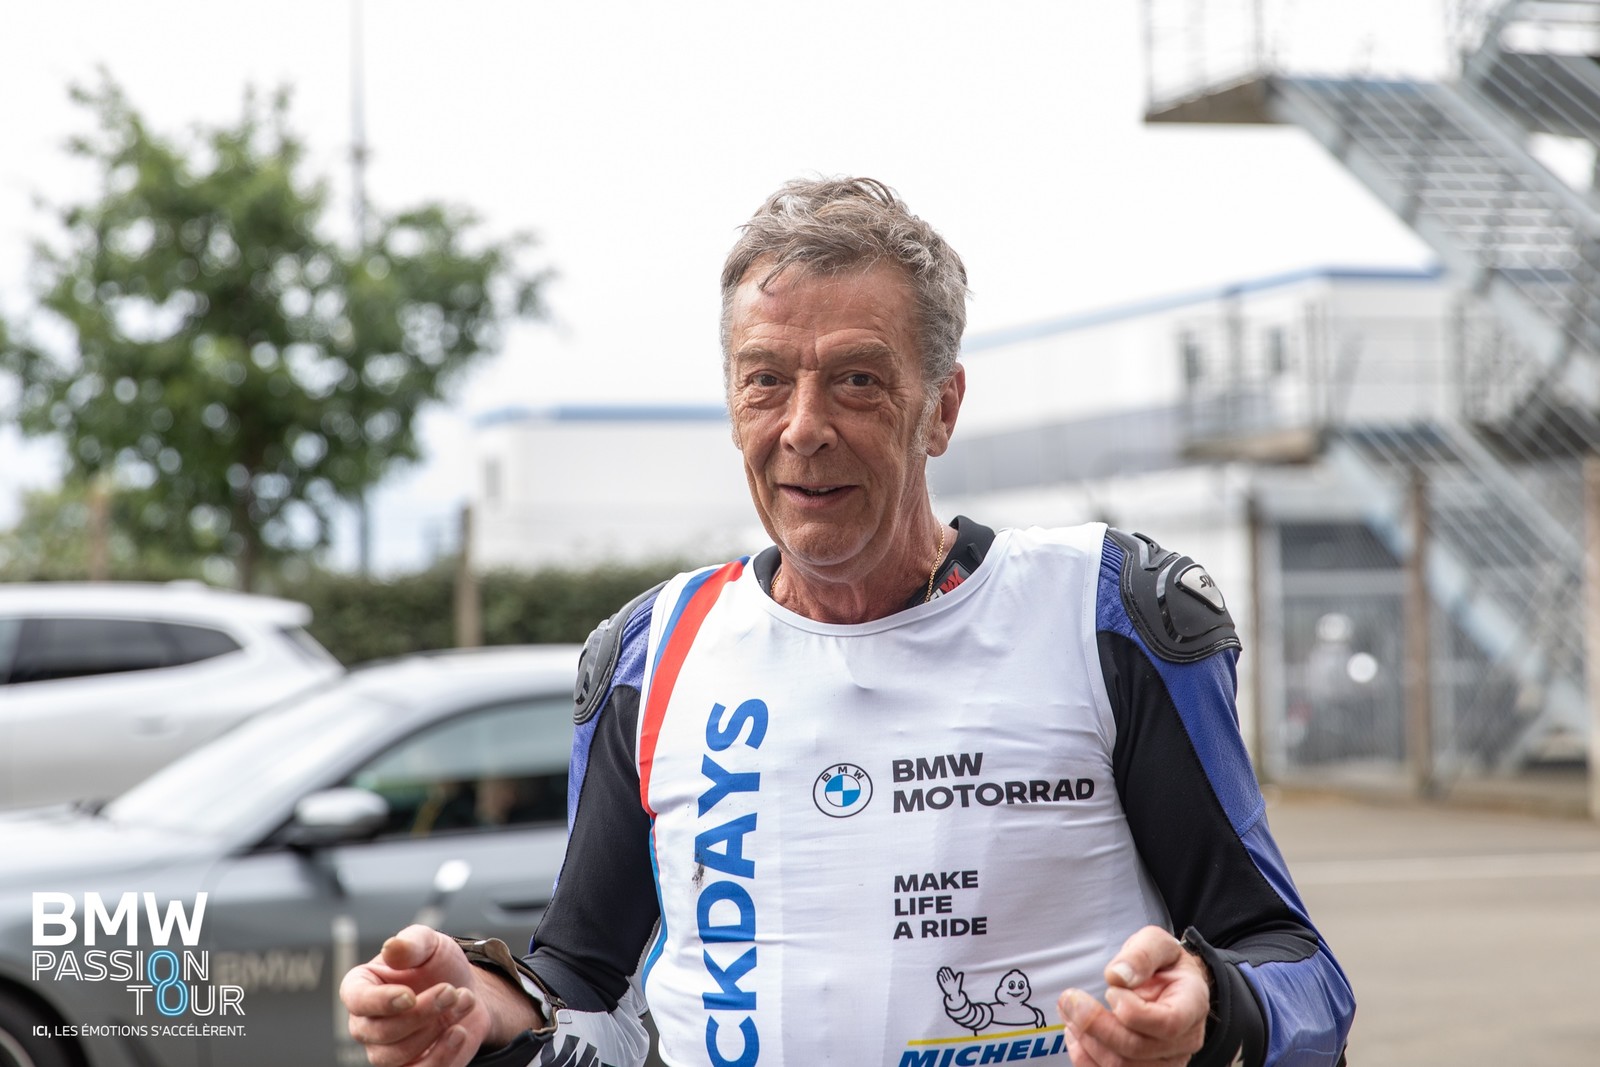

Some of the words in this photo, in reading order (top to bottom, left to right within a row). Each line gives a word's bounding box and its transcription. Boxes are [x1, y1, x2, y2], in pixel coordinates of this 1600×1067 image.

[821, 765, 865, 783] BMW
[892, 752, 983, 783] BMW
[893, 778, 1095, 813] MOTORRAD
[894, 870, 979, 893] MAKE
[894, 895, 952, 916] LIFE
[893, 921, 914, 940] A
[921, 916, 987, 938] RIDE
[898, 1034, 1068, 1067] MICHELI
